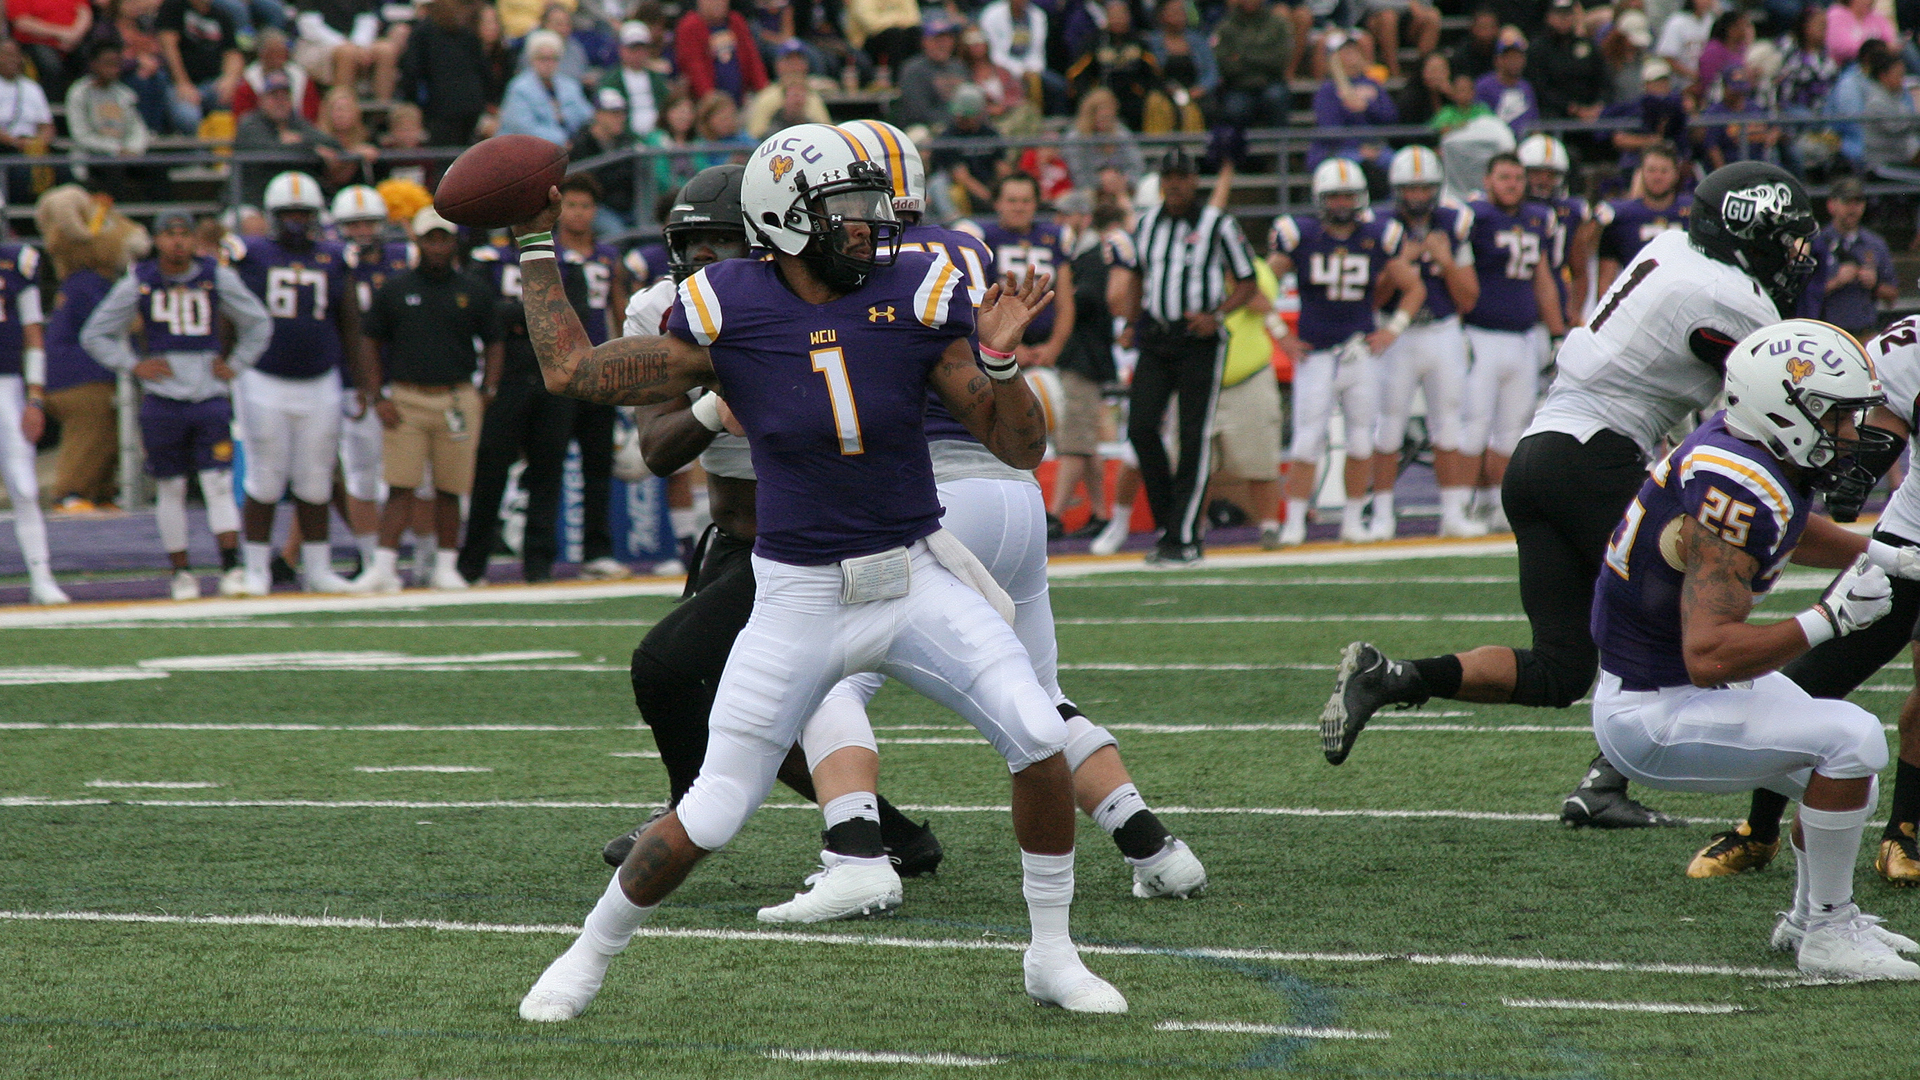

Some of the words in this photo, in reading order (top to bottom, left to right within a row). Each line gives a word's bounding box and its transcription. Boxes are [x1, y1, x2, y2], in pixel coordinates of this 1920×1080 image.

[760, 138, 823, 164] WCU
[893, 200, 920, 210] ddell
[1727, 200, 1754, 223] GU
[1495, 229, 1541, 280] 72
[267, 267, 329, 320] 67
[1309, 253, 1370, 300] 42
[152, 288, 212, 336] 40
[810, 329, 837, 345] WCU
[1769, 339, 1844, 369] WCU
[600, 352, 669, 390] SYRACUSE
[809, 346, 865, 456] 1
[1698, 485, 1757, 547] 25
